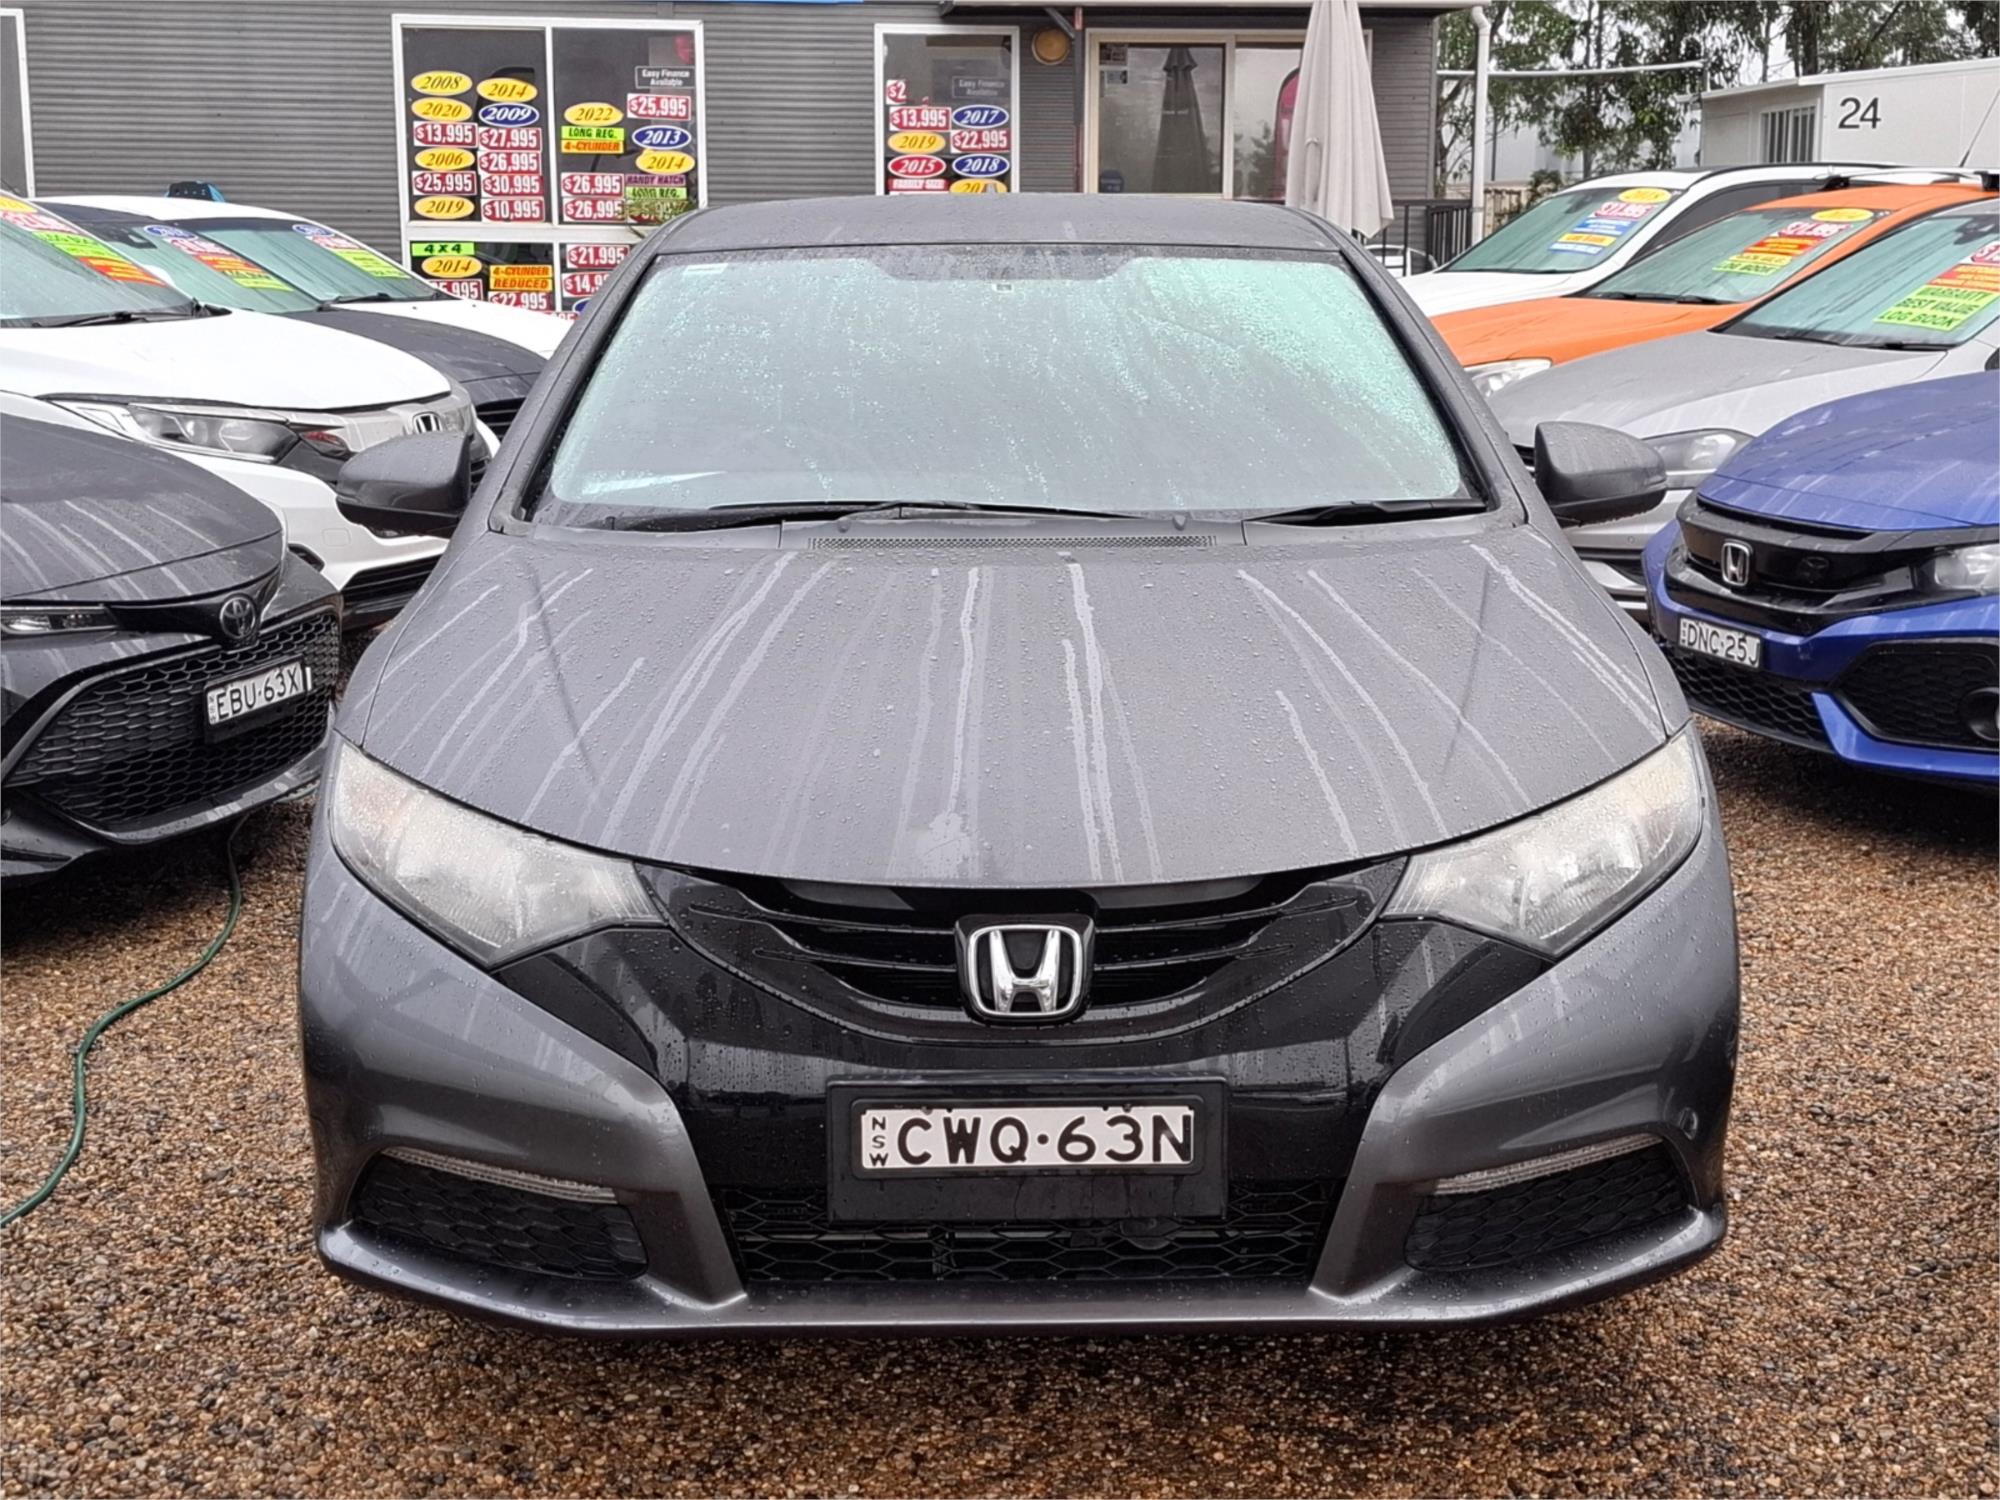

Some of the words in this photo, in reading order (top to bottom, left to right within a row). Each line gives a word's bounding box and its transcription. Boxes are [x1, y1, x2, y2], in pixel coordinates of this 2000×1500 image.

[420, 76, 462, 90] 2008
[488, 83, 528, 97] 2014
[422, 102, 462, 117] 2020
[485, 107, 531, 121] 2009
[631, 97, 686, 117] $25,995
[1838, 97, 1882, 129] 24
[575, 108, 613, 121] 2022
[892, 109, 947, 127] $13,995
[961, 109, 999, 124] 2017
[416, 125, 473, 143] $13,995
[482, 129, 537, 148] $27,995
[568, 128, 592, 137] LONG
[642, 130, 682, 144] 2013
[954, 130, 1008, 148] $22,995
[564, 141, 620, 151] 4-CYLINDER
[899, 135, 937, 149] 2019
[426, 152, 463, 166] 2006
[481, 153, 537, 171] $26,995
[647, 156, 685, 169] 2014
[962, 159, 1000, 172] 2018
[900, 160, 936, 173] 2015
[415, 172, 472, 191] $25,995
[484, 175, 540, 194] $30,995
[564, 175, 620, 194] $26,995
[425, 200, 464, 214] 2019
[484, 200, 540, 219] $10,995
[566, 201, 622, 219] $26,995
[570, 246, 624, 266] $21,995
[433, 260, 471, 272] 2014
[493, 266, 549, 276] 4-CYLINDER
[494, 279, 548, 288] REDUCED
[897, 1114, 1192, 1165] CWQ·63N
